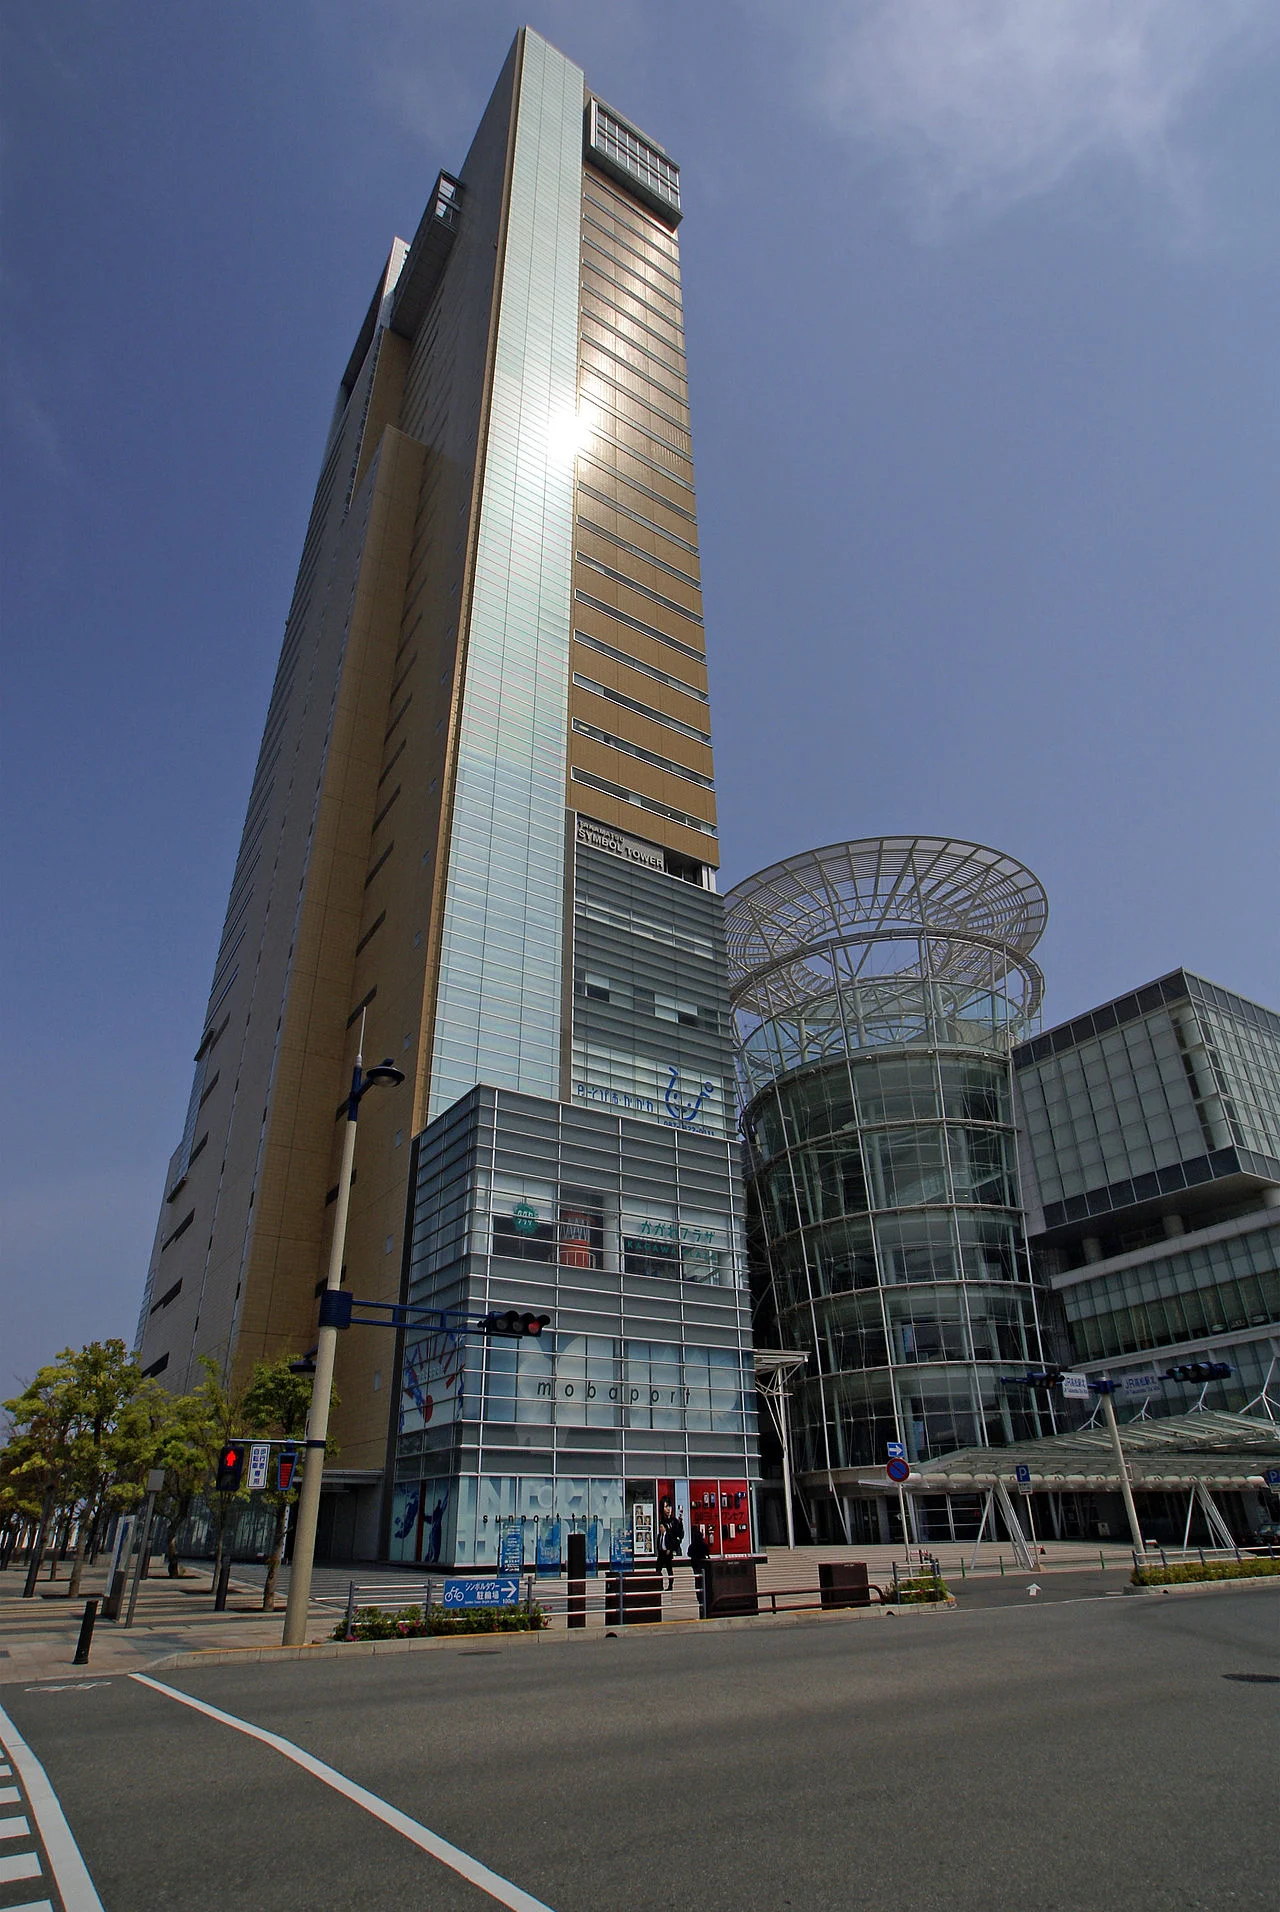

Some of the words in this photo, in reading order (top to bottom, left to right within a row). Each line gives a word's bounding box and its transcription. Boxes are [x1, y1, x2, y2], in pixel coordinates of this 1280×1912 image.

[579, 819, 625, 842] TAKAMATSU
[578, 828, 623, 854] SYMBOL
[625, 847, 663, 869] TOWER
[627, 1240, 678, 1256] KAGAWA
[537, 1380, 690, 1405] mobaport
